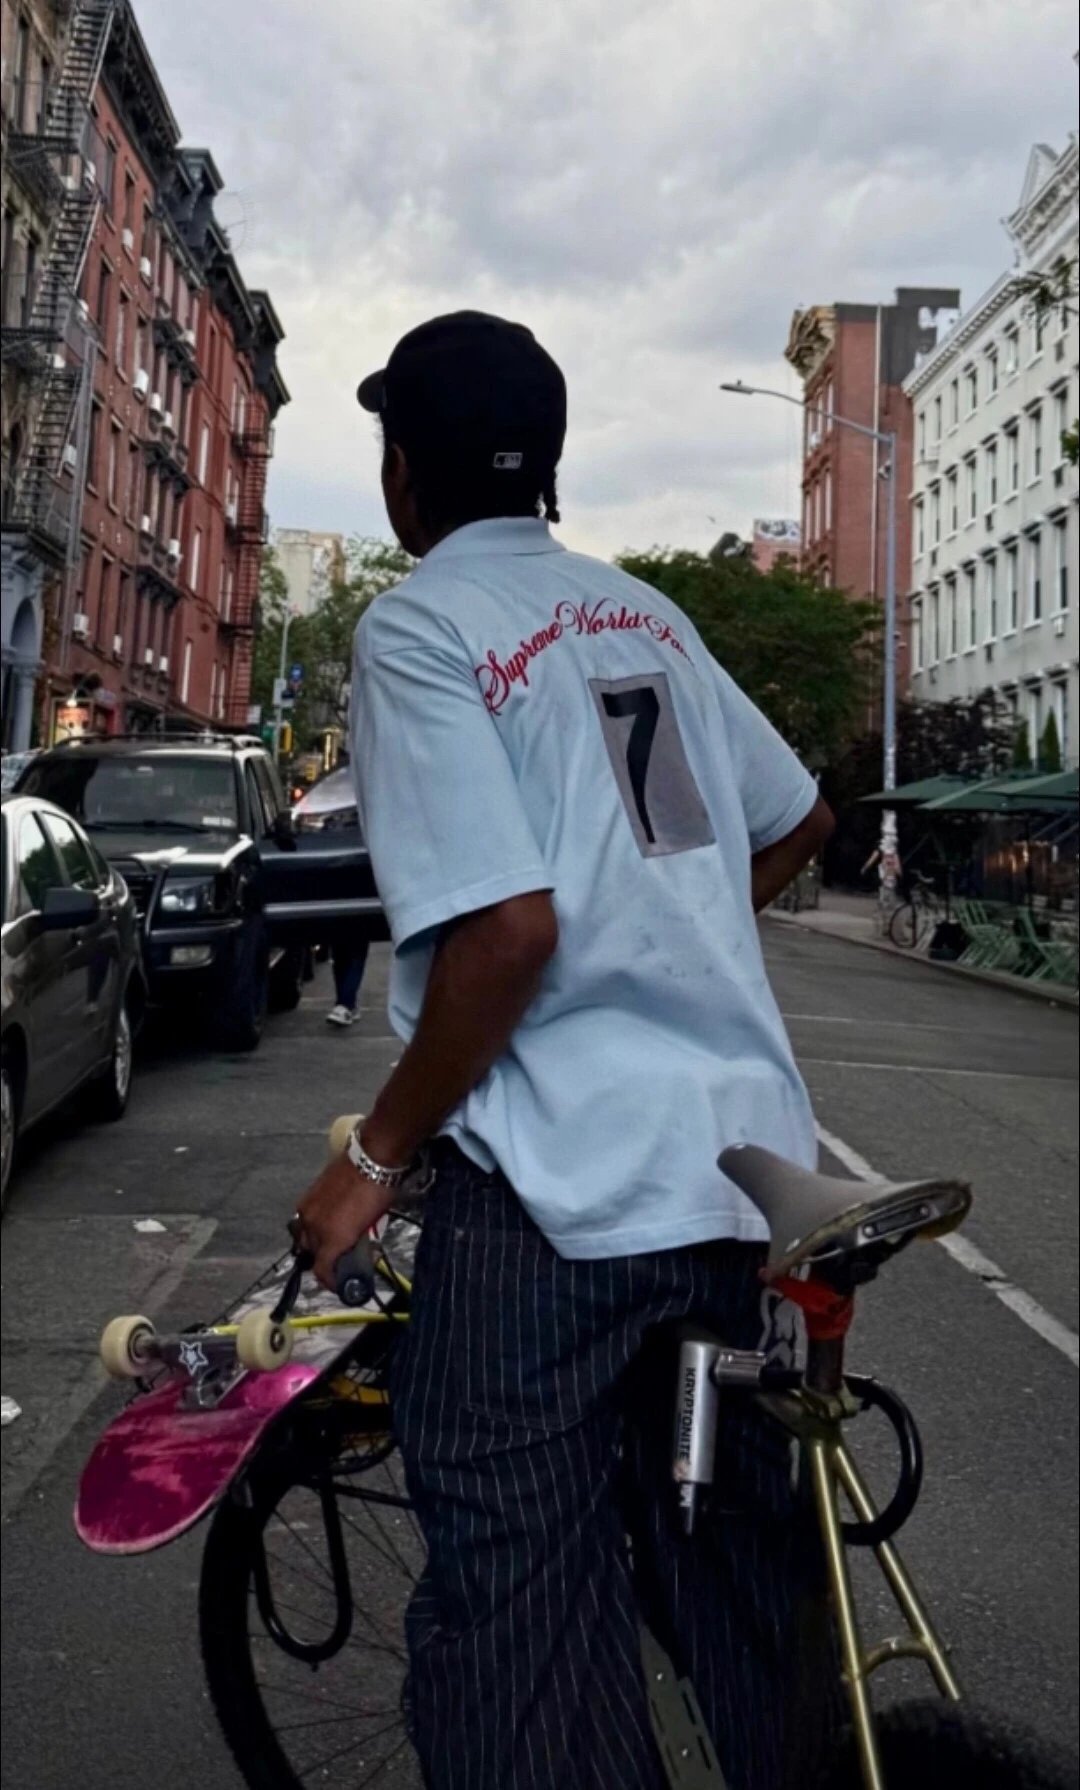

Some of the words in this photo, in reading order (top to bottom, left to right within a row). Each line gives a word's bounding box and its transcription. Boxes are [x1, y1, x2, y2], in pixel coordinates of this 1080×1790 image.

[474, 621, 563, 716] Supreme
[555, 597, 642, 636] World
[601, 686, 661, 844] 7
[679, 1366, 696, 1461] KRYPTONITE
